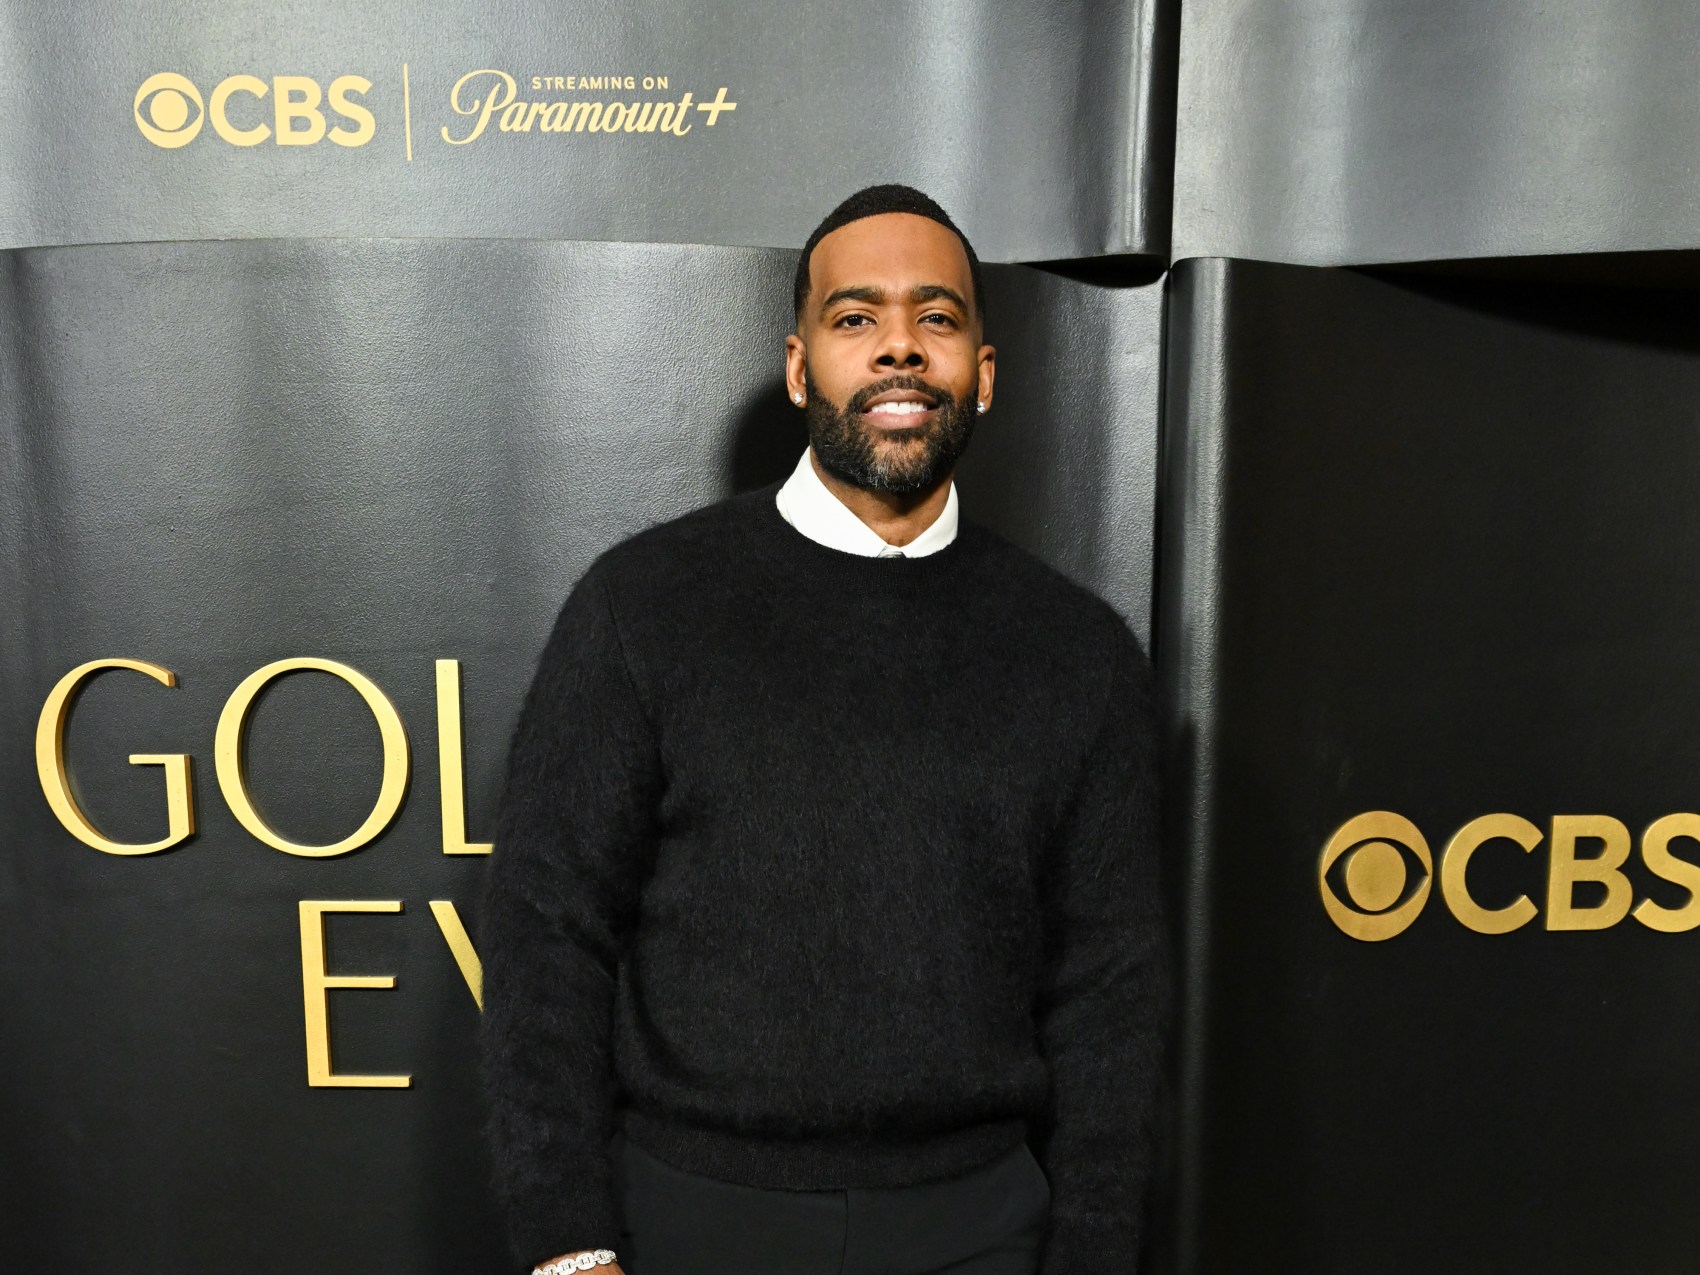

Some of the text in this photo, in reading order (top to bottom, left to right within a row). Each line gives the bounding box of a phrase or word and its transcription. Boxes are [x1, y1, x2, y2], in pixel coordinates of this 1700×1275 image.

[208, 74, 376, 148] CBS
[441, 69, 737, 145] Paramount+
[531, 76, 669, 90] STREAMING ON
[1440, 812, 1700, 935] CBS
